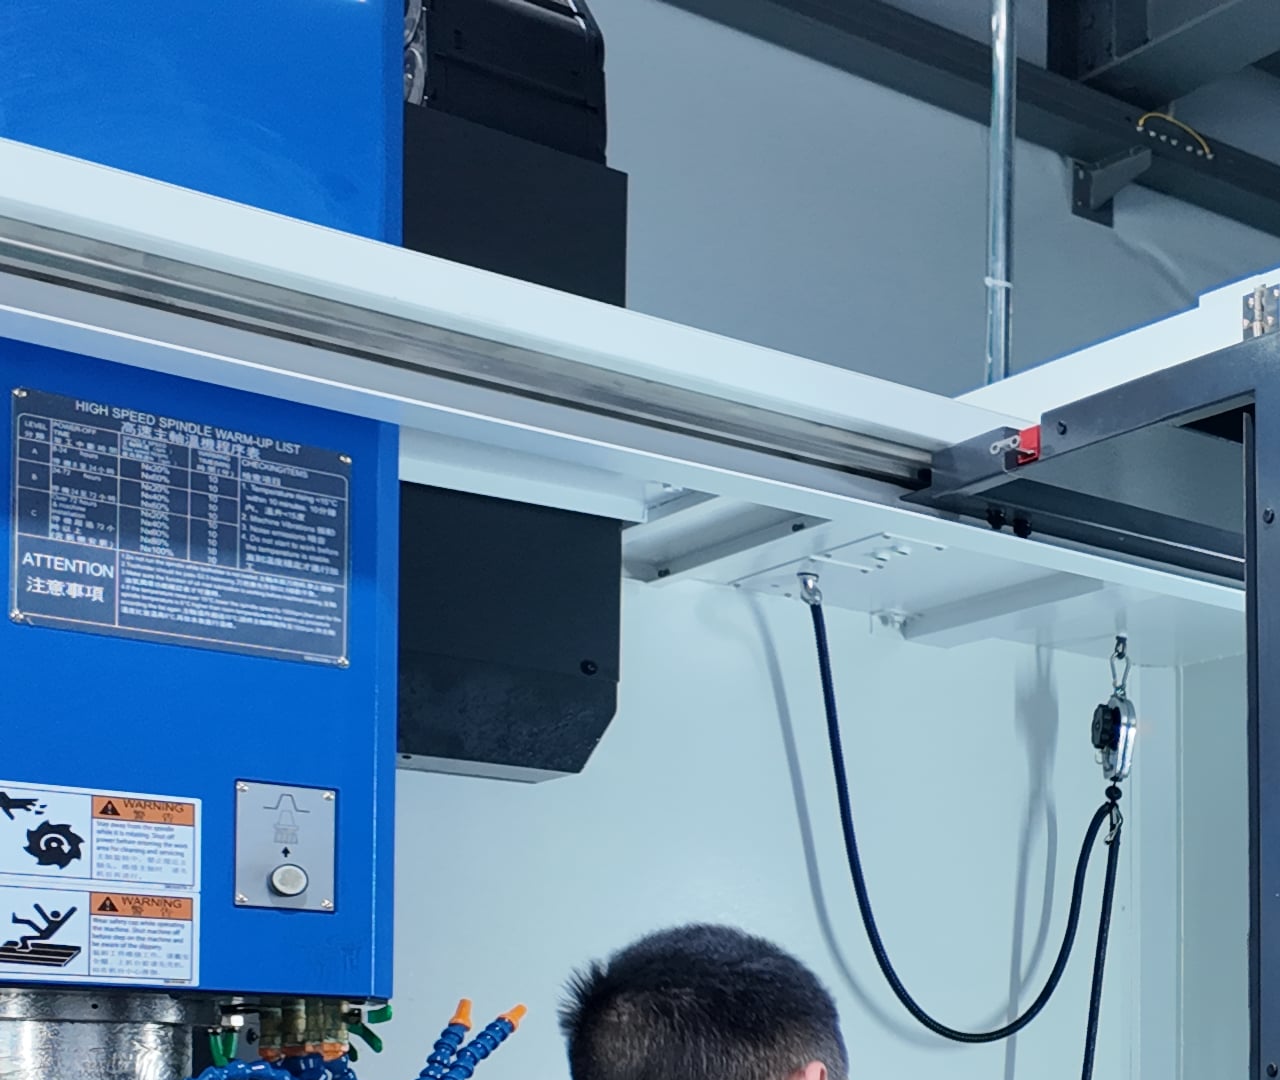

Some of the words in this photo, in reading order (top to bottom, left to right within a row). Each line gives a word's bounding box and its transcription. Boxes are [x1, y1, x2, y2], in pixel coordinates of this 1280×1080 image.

[75, 400, 109, 416] HIGH
[112, 407, 156, 426] SPEED
[159, 417, 212, 437] SPINDLE
[215, 428, 273, 449] WARM-UP
[275, 440, 301, 455] LIST
[31, 447, 38, 455] A
[30, 509, 37, 517] C
[22, 552, 114, 579] ATTENTION
[26, 575, 105, 603] 注意事項
[123, 799, 184, 813] WARNING
[121, 896, 182, 909] WARNING
